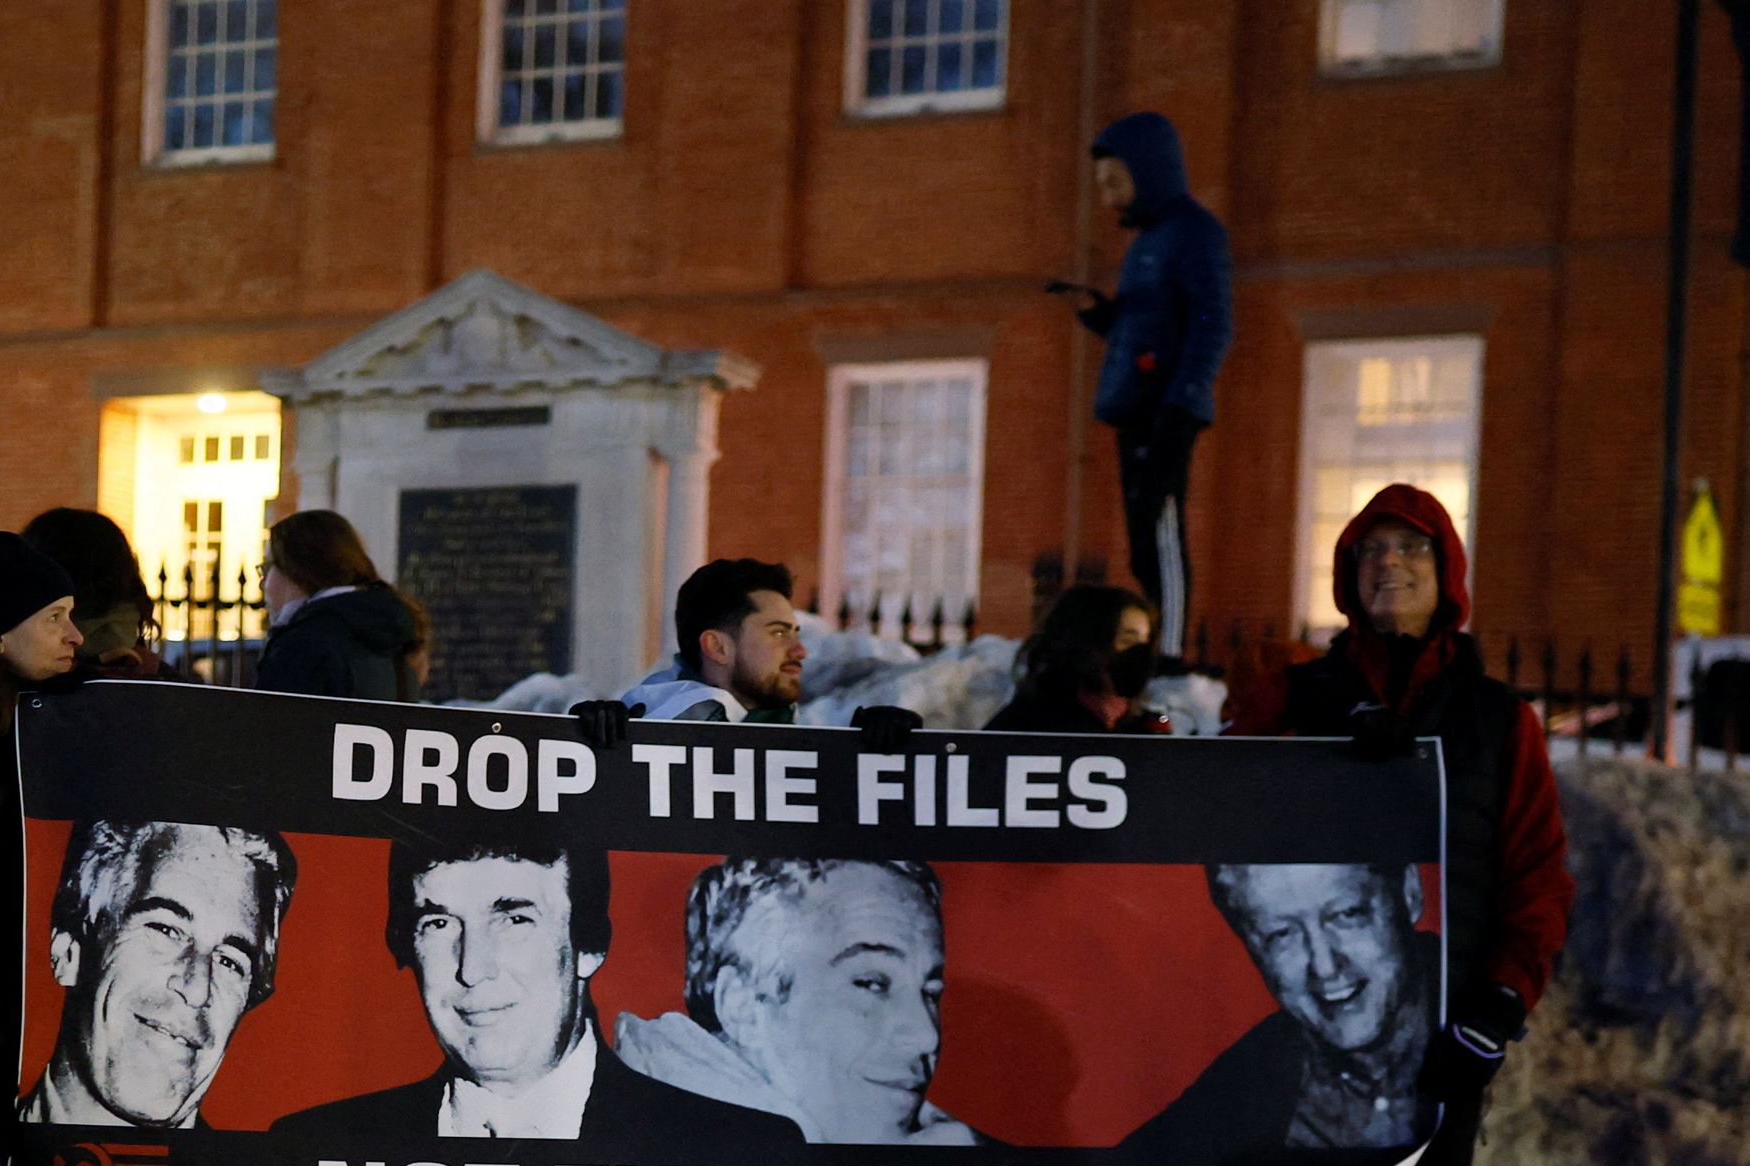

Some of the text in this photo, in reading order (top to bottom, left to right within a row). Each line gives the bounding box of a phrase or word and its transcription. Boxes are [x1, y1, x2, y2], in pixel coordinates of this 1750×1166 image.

[331, 722, 1128, 829] DROP THE FILES
